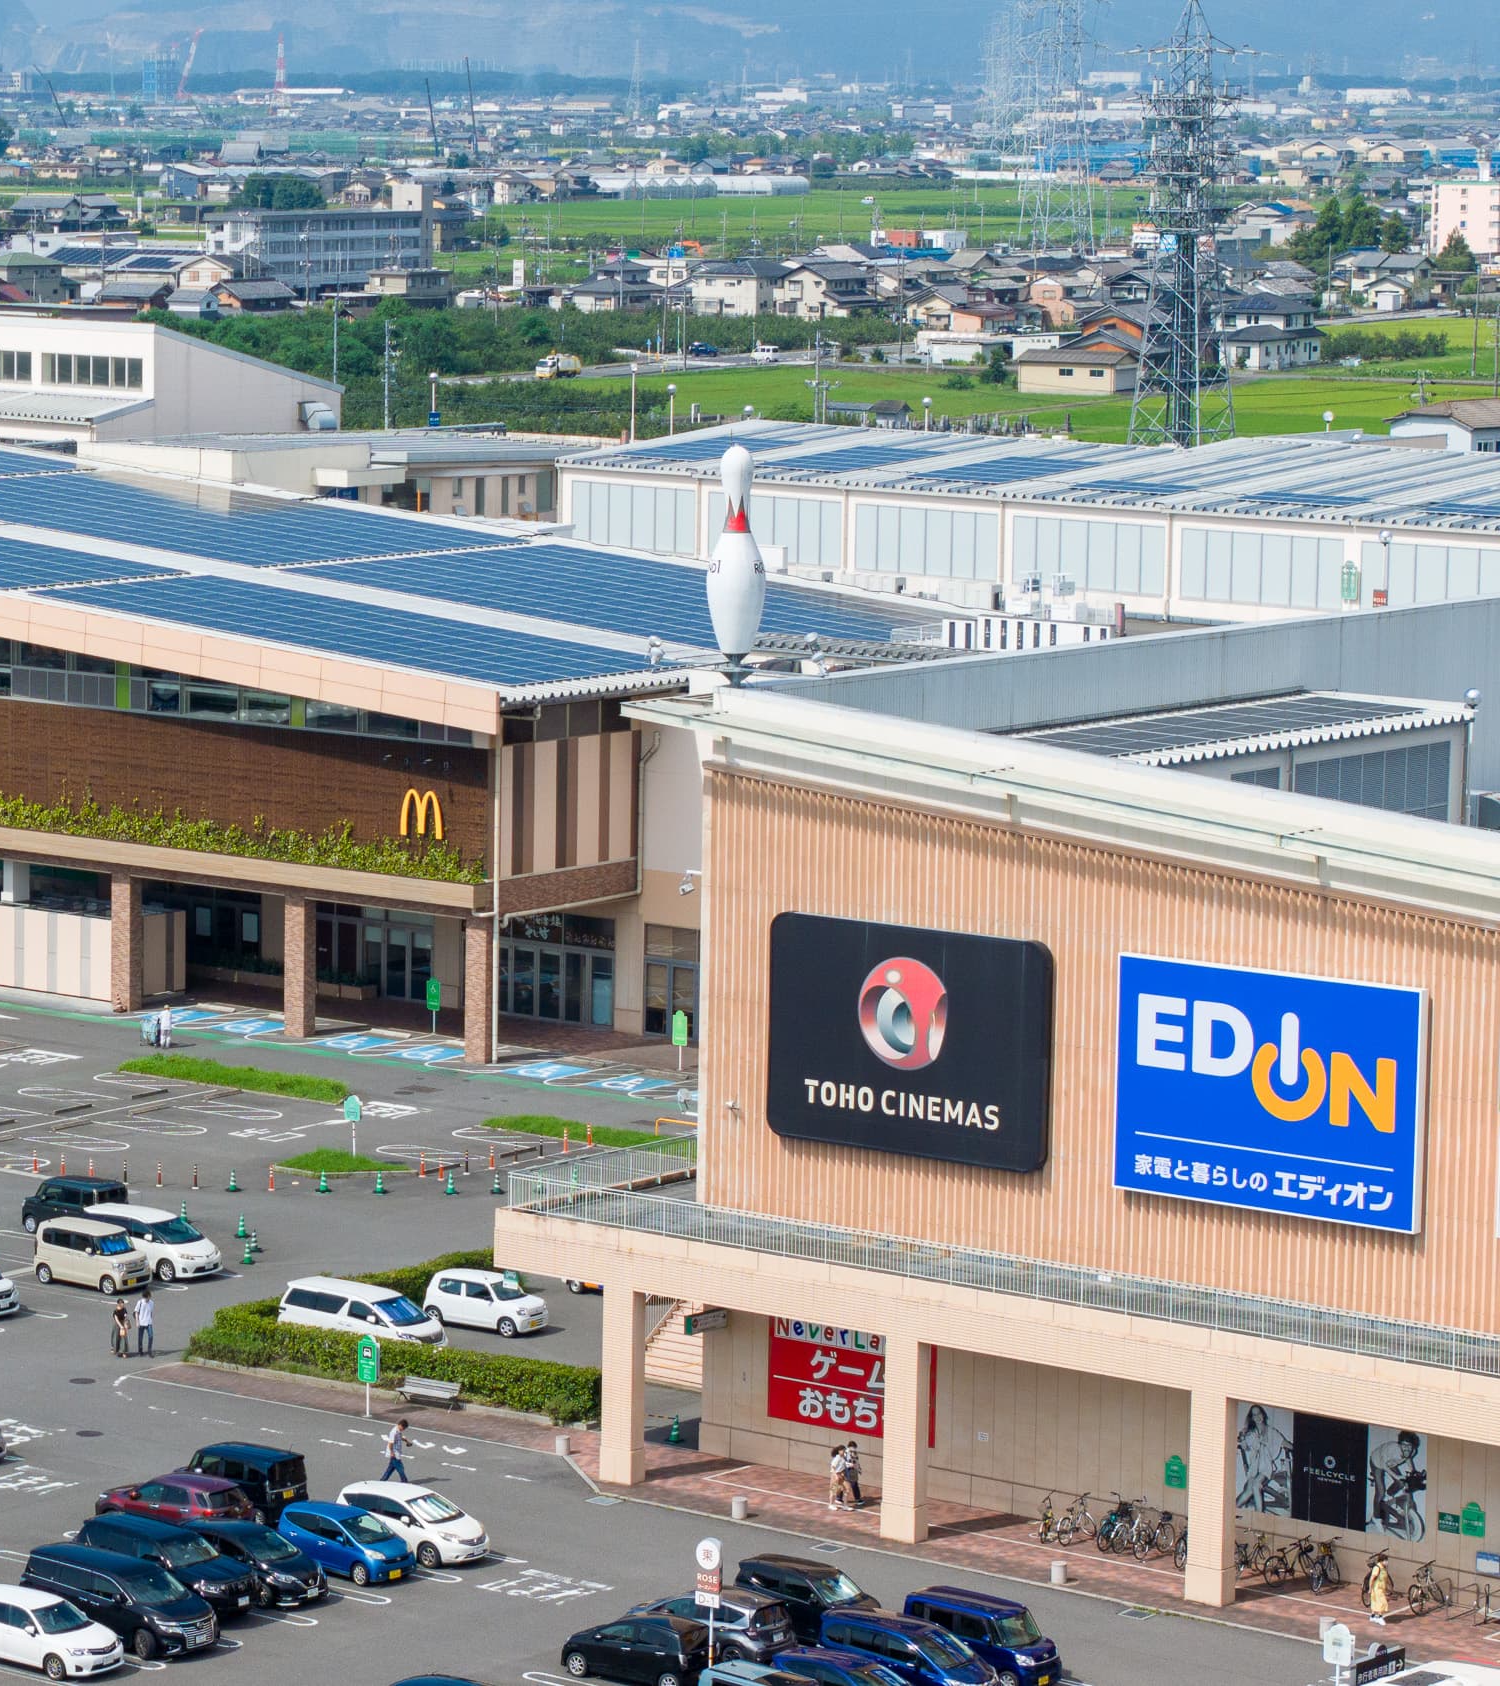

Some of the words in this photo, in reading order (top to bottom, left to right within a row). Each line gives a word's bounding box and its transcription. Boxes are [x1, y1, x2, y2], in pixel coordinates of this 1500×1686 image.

[1136, 992, 1397, 1134] EDION
[804, 1078, 874, 1112] TOHO
[881, 1089, 1000, 1132] CINEMAS
[1134, 1153, 1268, 1192] 家電と暮らしの
[1272, 1170, 1394, 1212] エディオン
[776, 1316, 884, 1351] NeverLa
[798, 1387, 885, 1429] おもち
[1303, 1466, 1356, 1482] FEELCYCLE
[696, 1572, 719, 1584] ROSE
